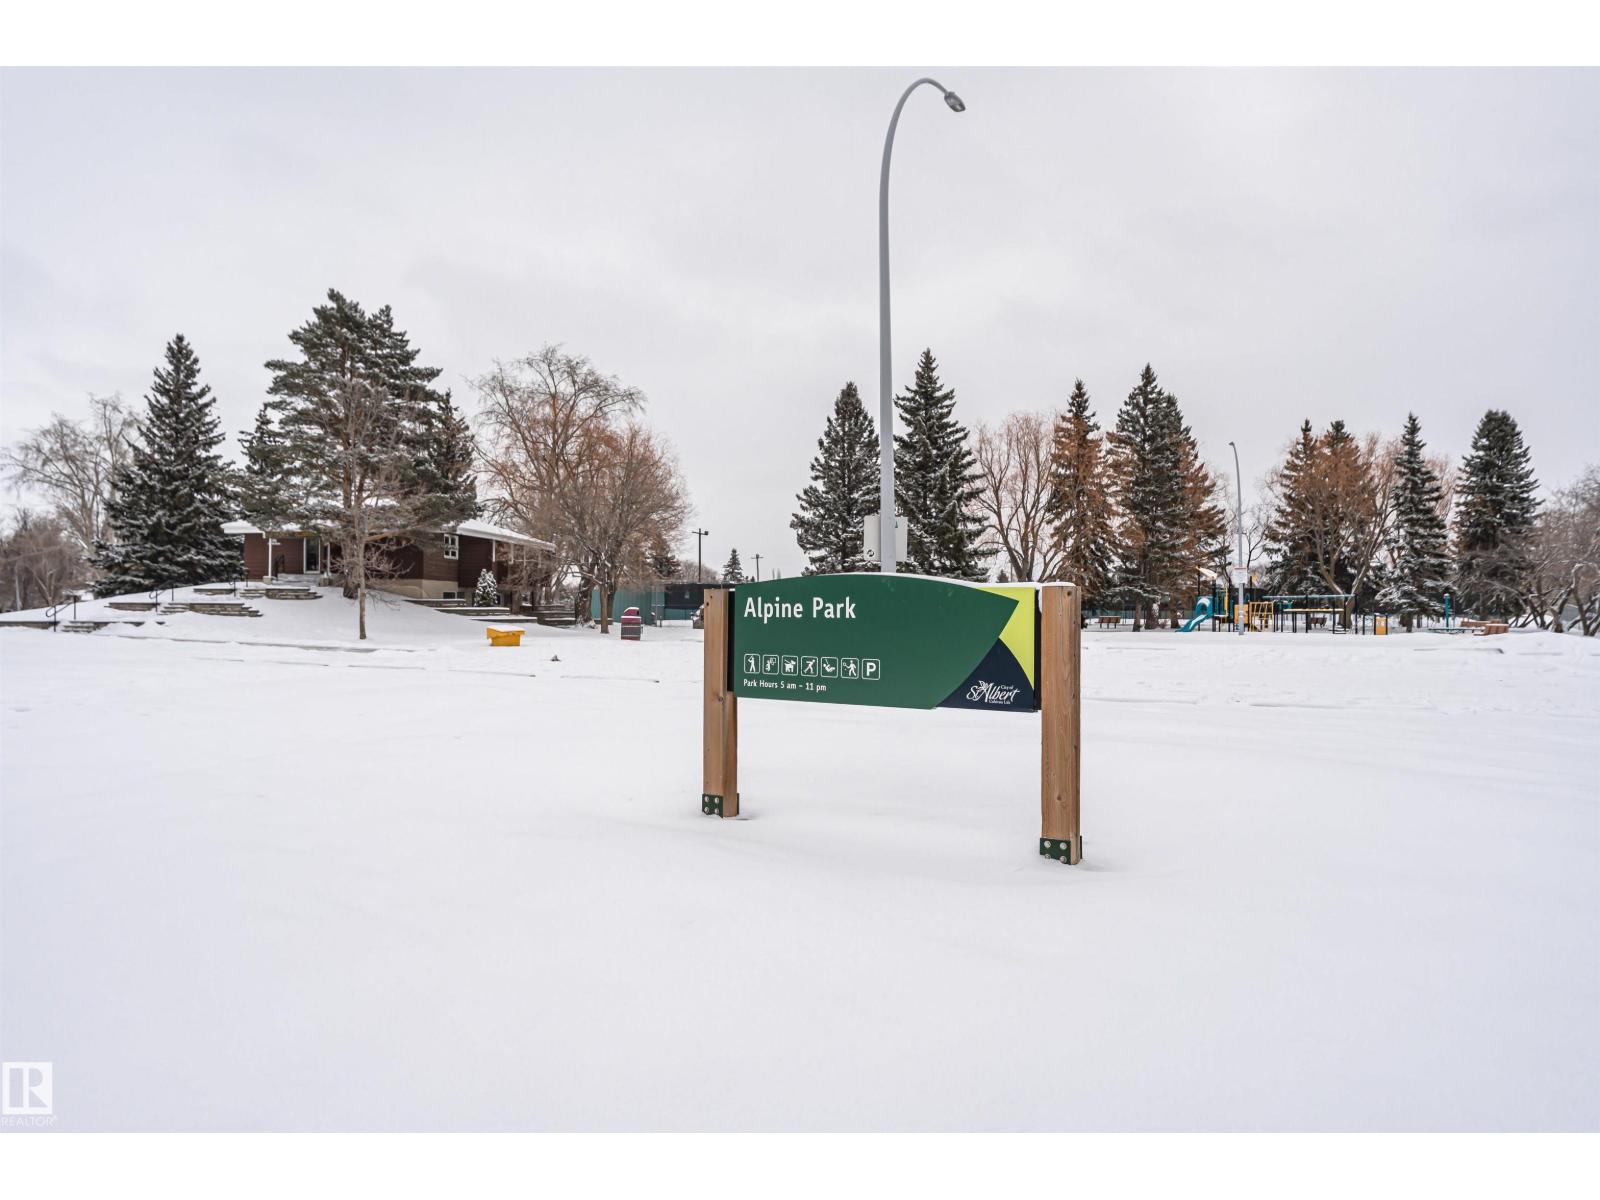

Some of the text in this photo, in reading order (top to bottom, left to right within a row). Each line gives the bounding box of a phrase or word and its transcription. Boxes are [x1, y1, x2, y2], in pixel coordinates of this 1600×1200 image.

[744, 596, 856, 624] Alpine Park
[743, 679, 757, 688] Park
[760, 680, 778, 689] Hours
[780, 681, 785, 689] 5
[805, 682, 814, 691] 11
[816, 684, 827, 693] pm
[978, 681, 1020, 703] Albert
